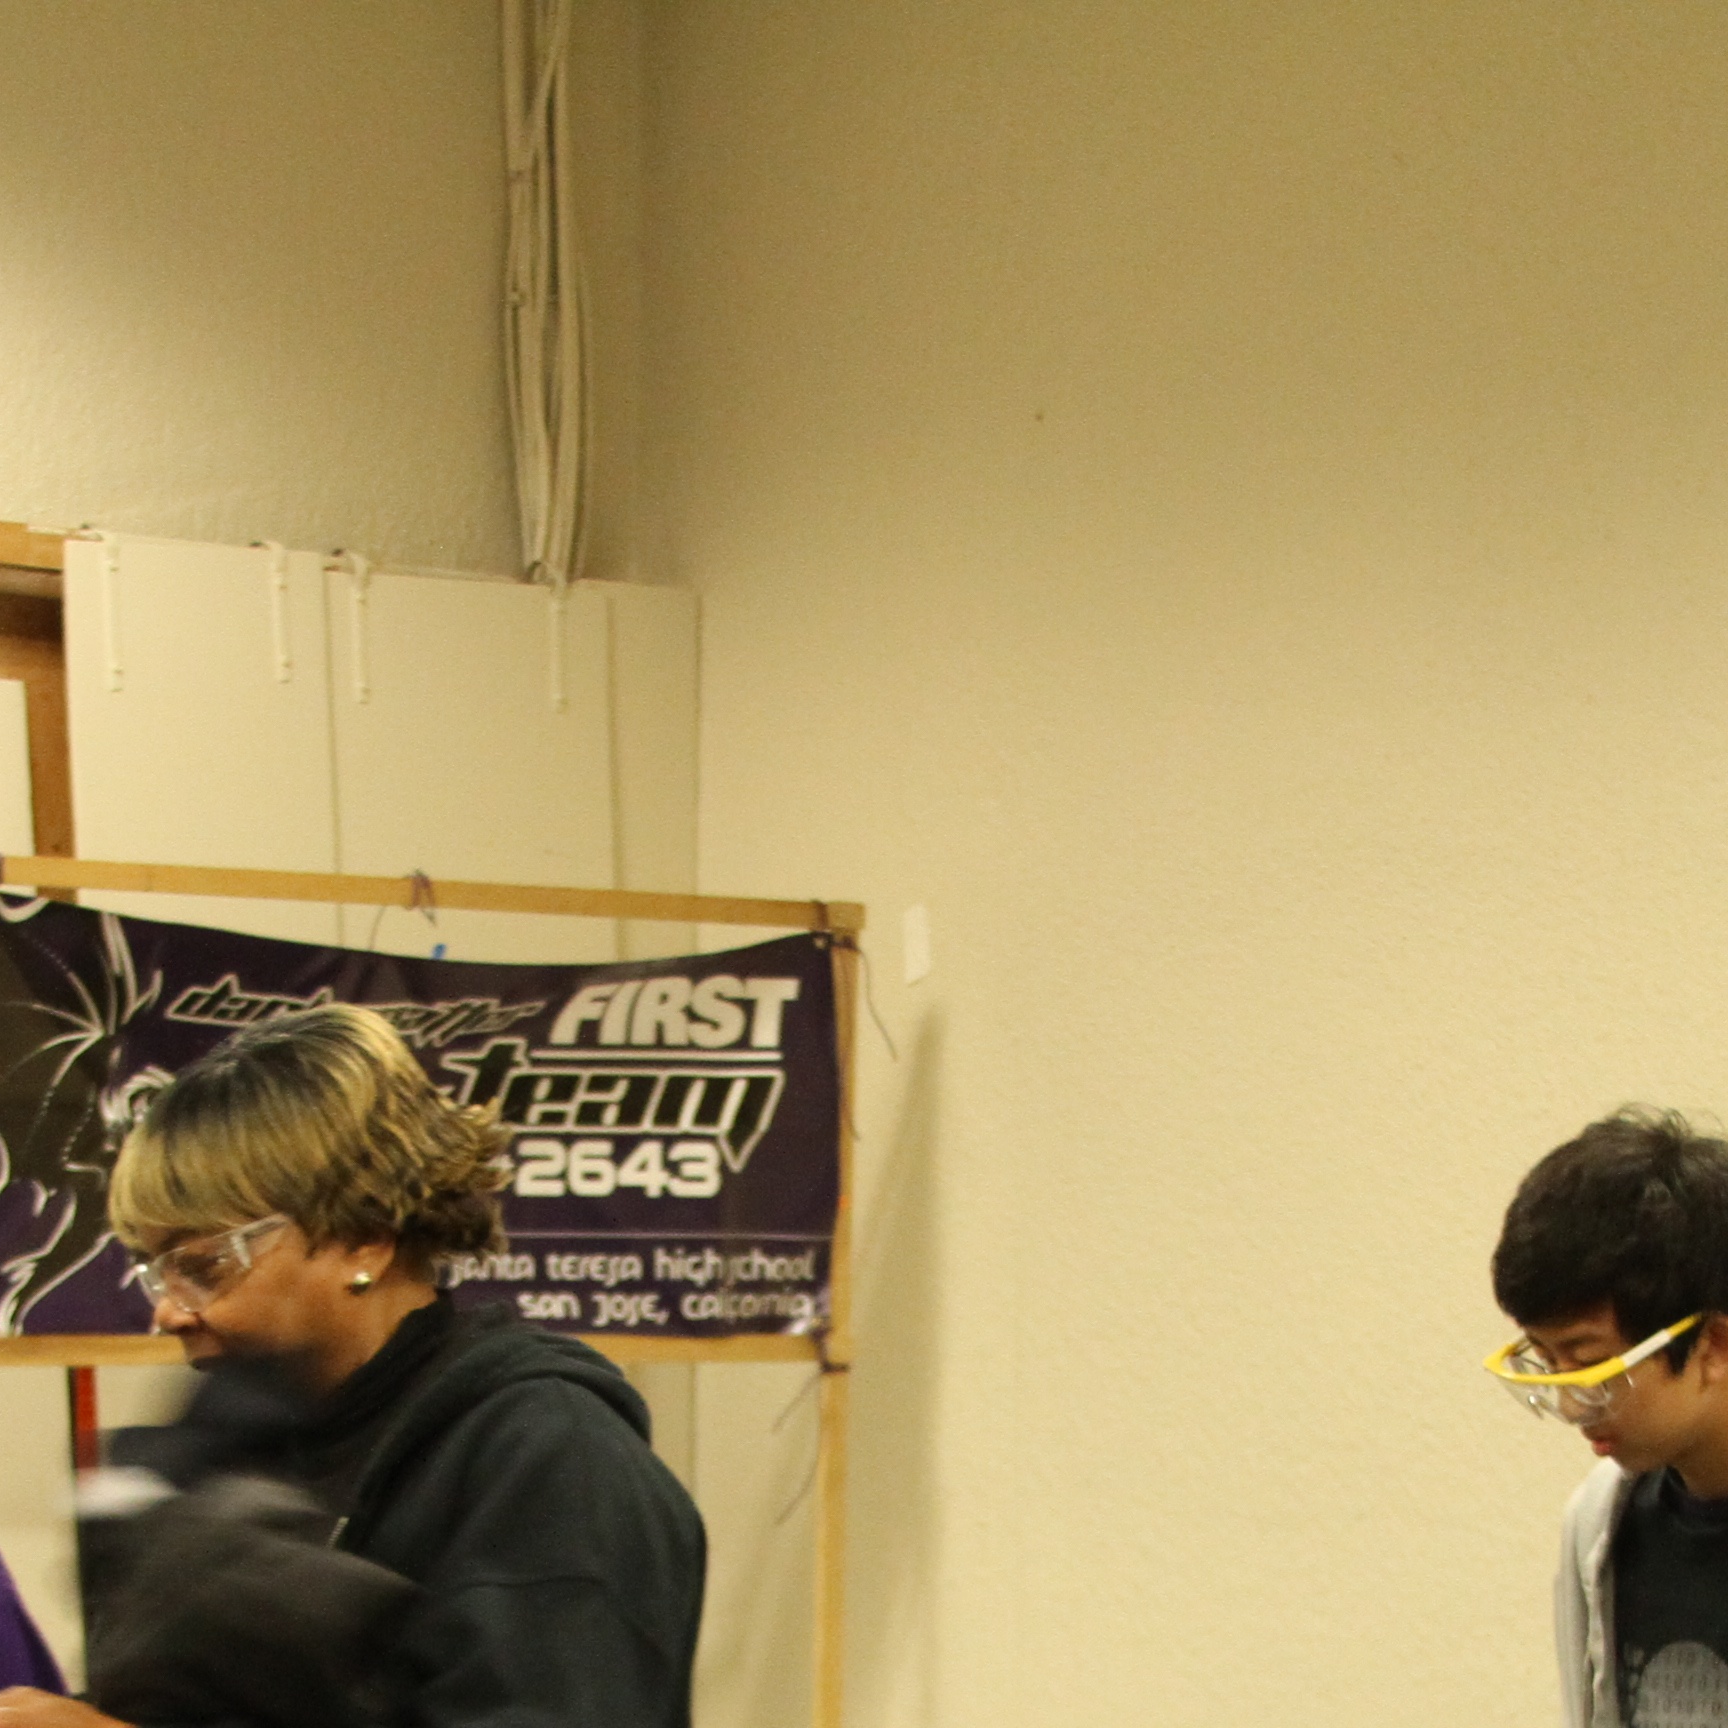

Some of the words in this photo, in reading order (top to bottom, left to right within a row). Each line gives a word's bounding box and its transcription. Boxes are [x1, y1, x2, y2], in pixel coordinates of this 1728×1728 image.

[549, 974, 800, 1049] FIRST
[442, 1037, 784, 1173] team
[502, 1139, 722, 1199] 2643
[516, 1291, 582, 1320] san
